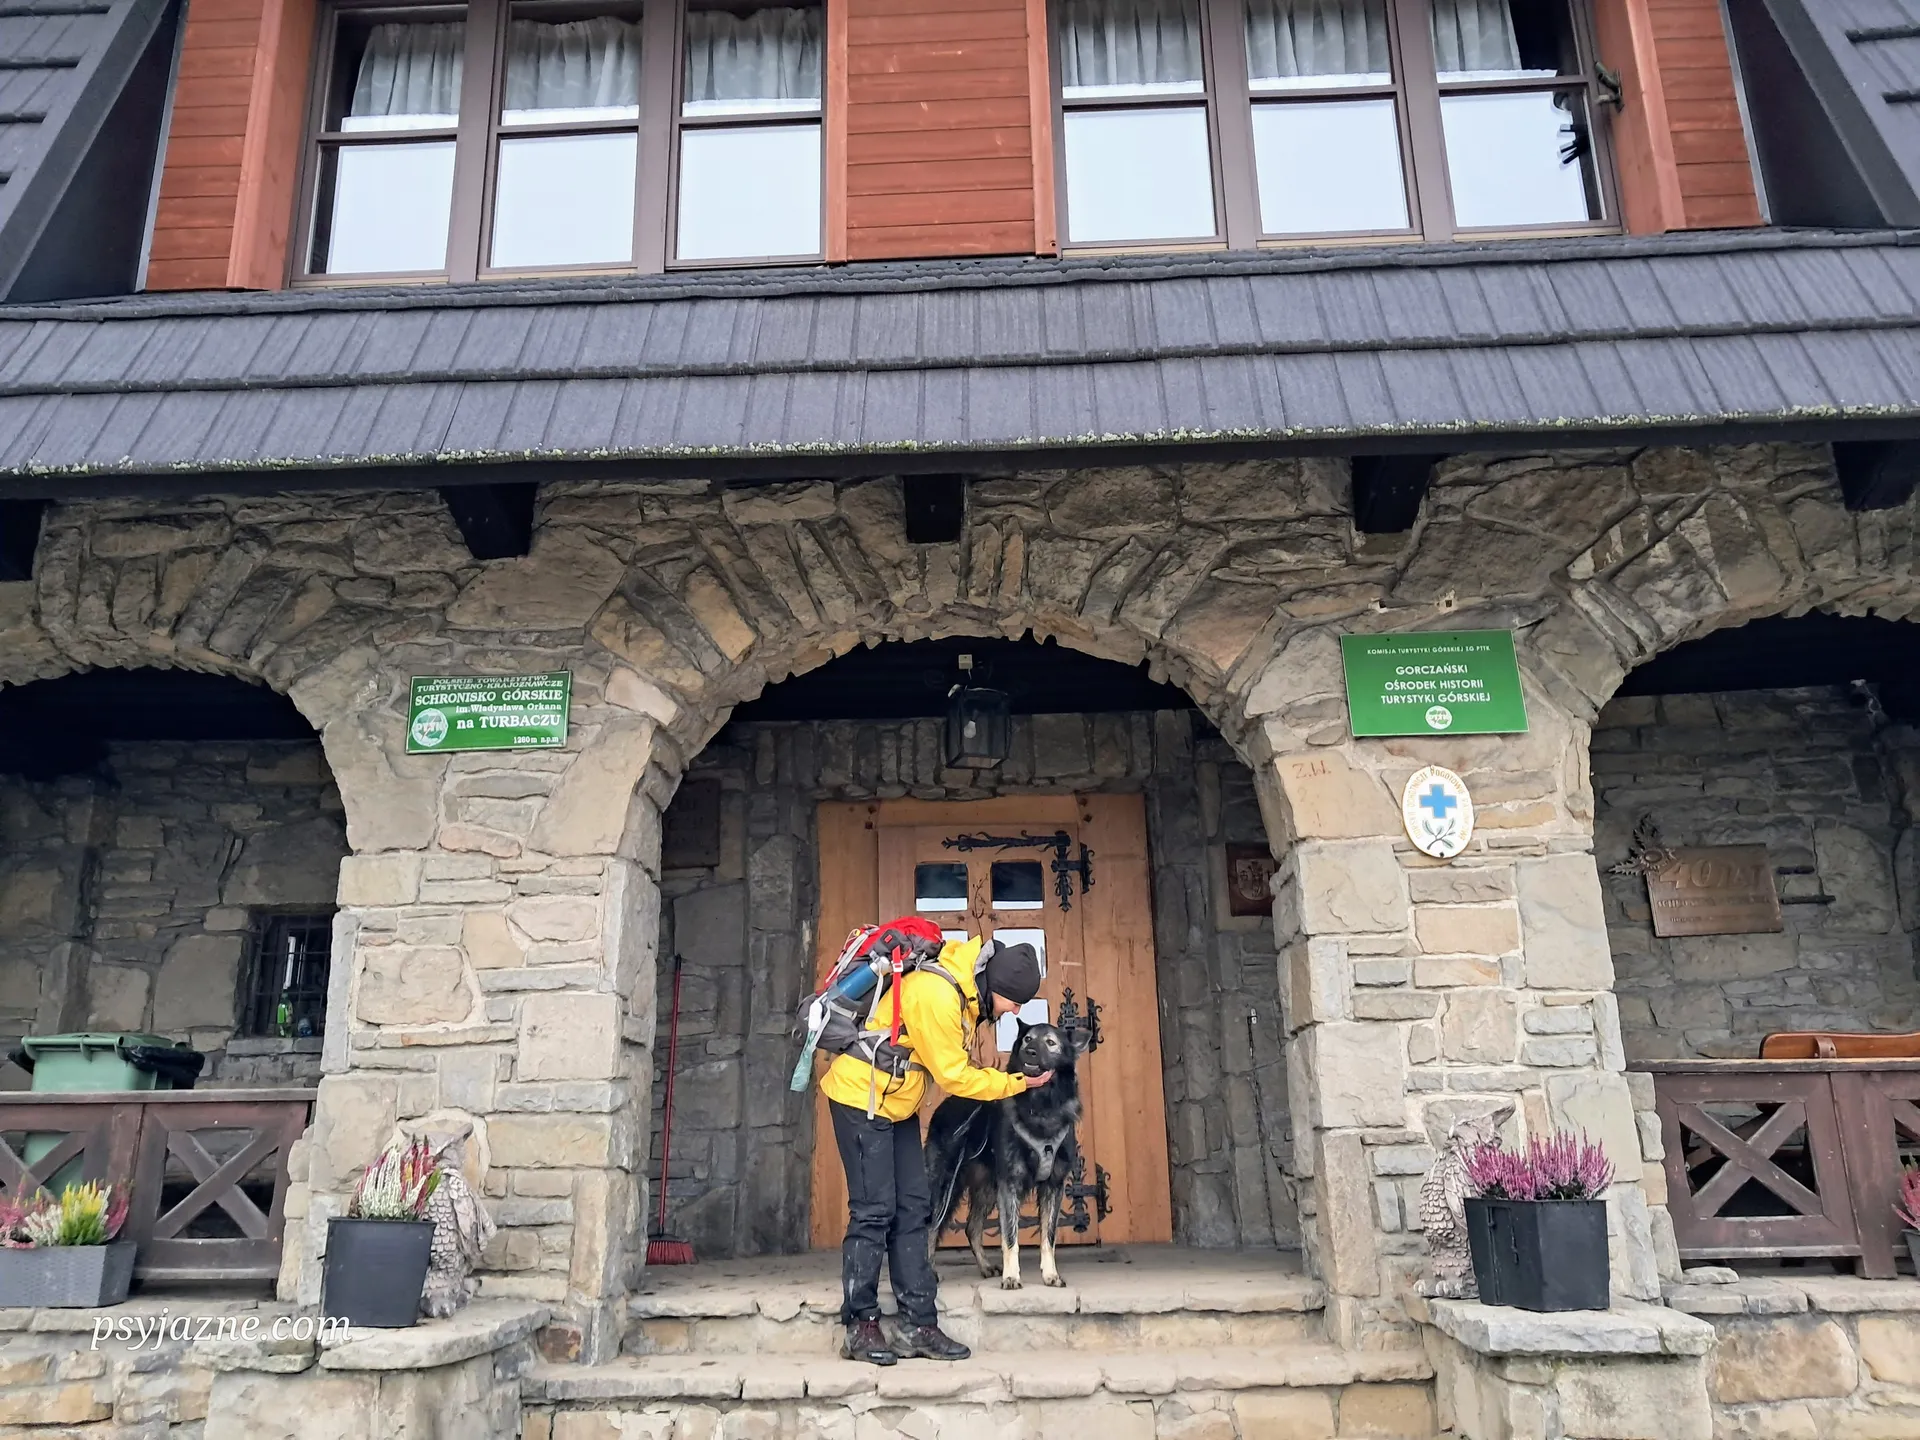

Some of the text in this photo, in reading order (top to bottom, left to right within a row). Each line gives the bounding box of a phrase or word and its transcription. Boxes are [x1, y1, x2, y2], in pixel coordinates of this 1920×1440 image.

[1395, 663, 1468, 675] GORCZAŃSKI
[477, 675, 548, 684] TOWARZYSTWO
[1384, 679, 1484, 691] OŚRODEK HISTORII
[415, 688, 563, 706] SCHRONISKO GÓRSKIE
[1380, 691, 1491, 704] TURYSTYKI GÓRSKIEJ
[527, 702, 562, 711] Orkana
[456, 714, 561, 729] na TURBACZU
